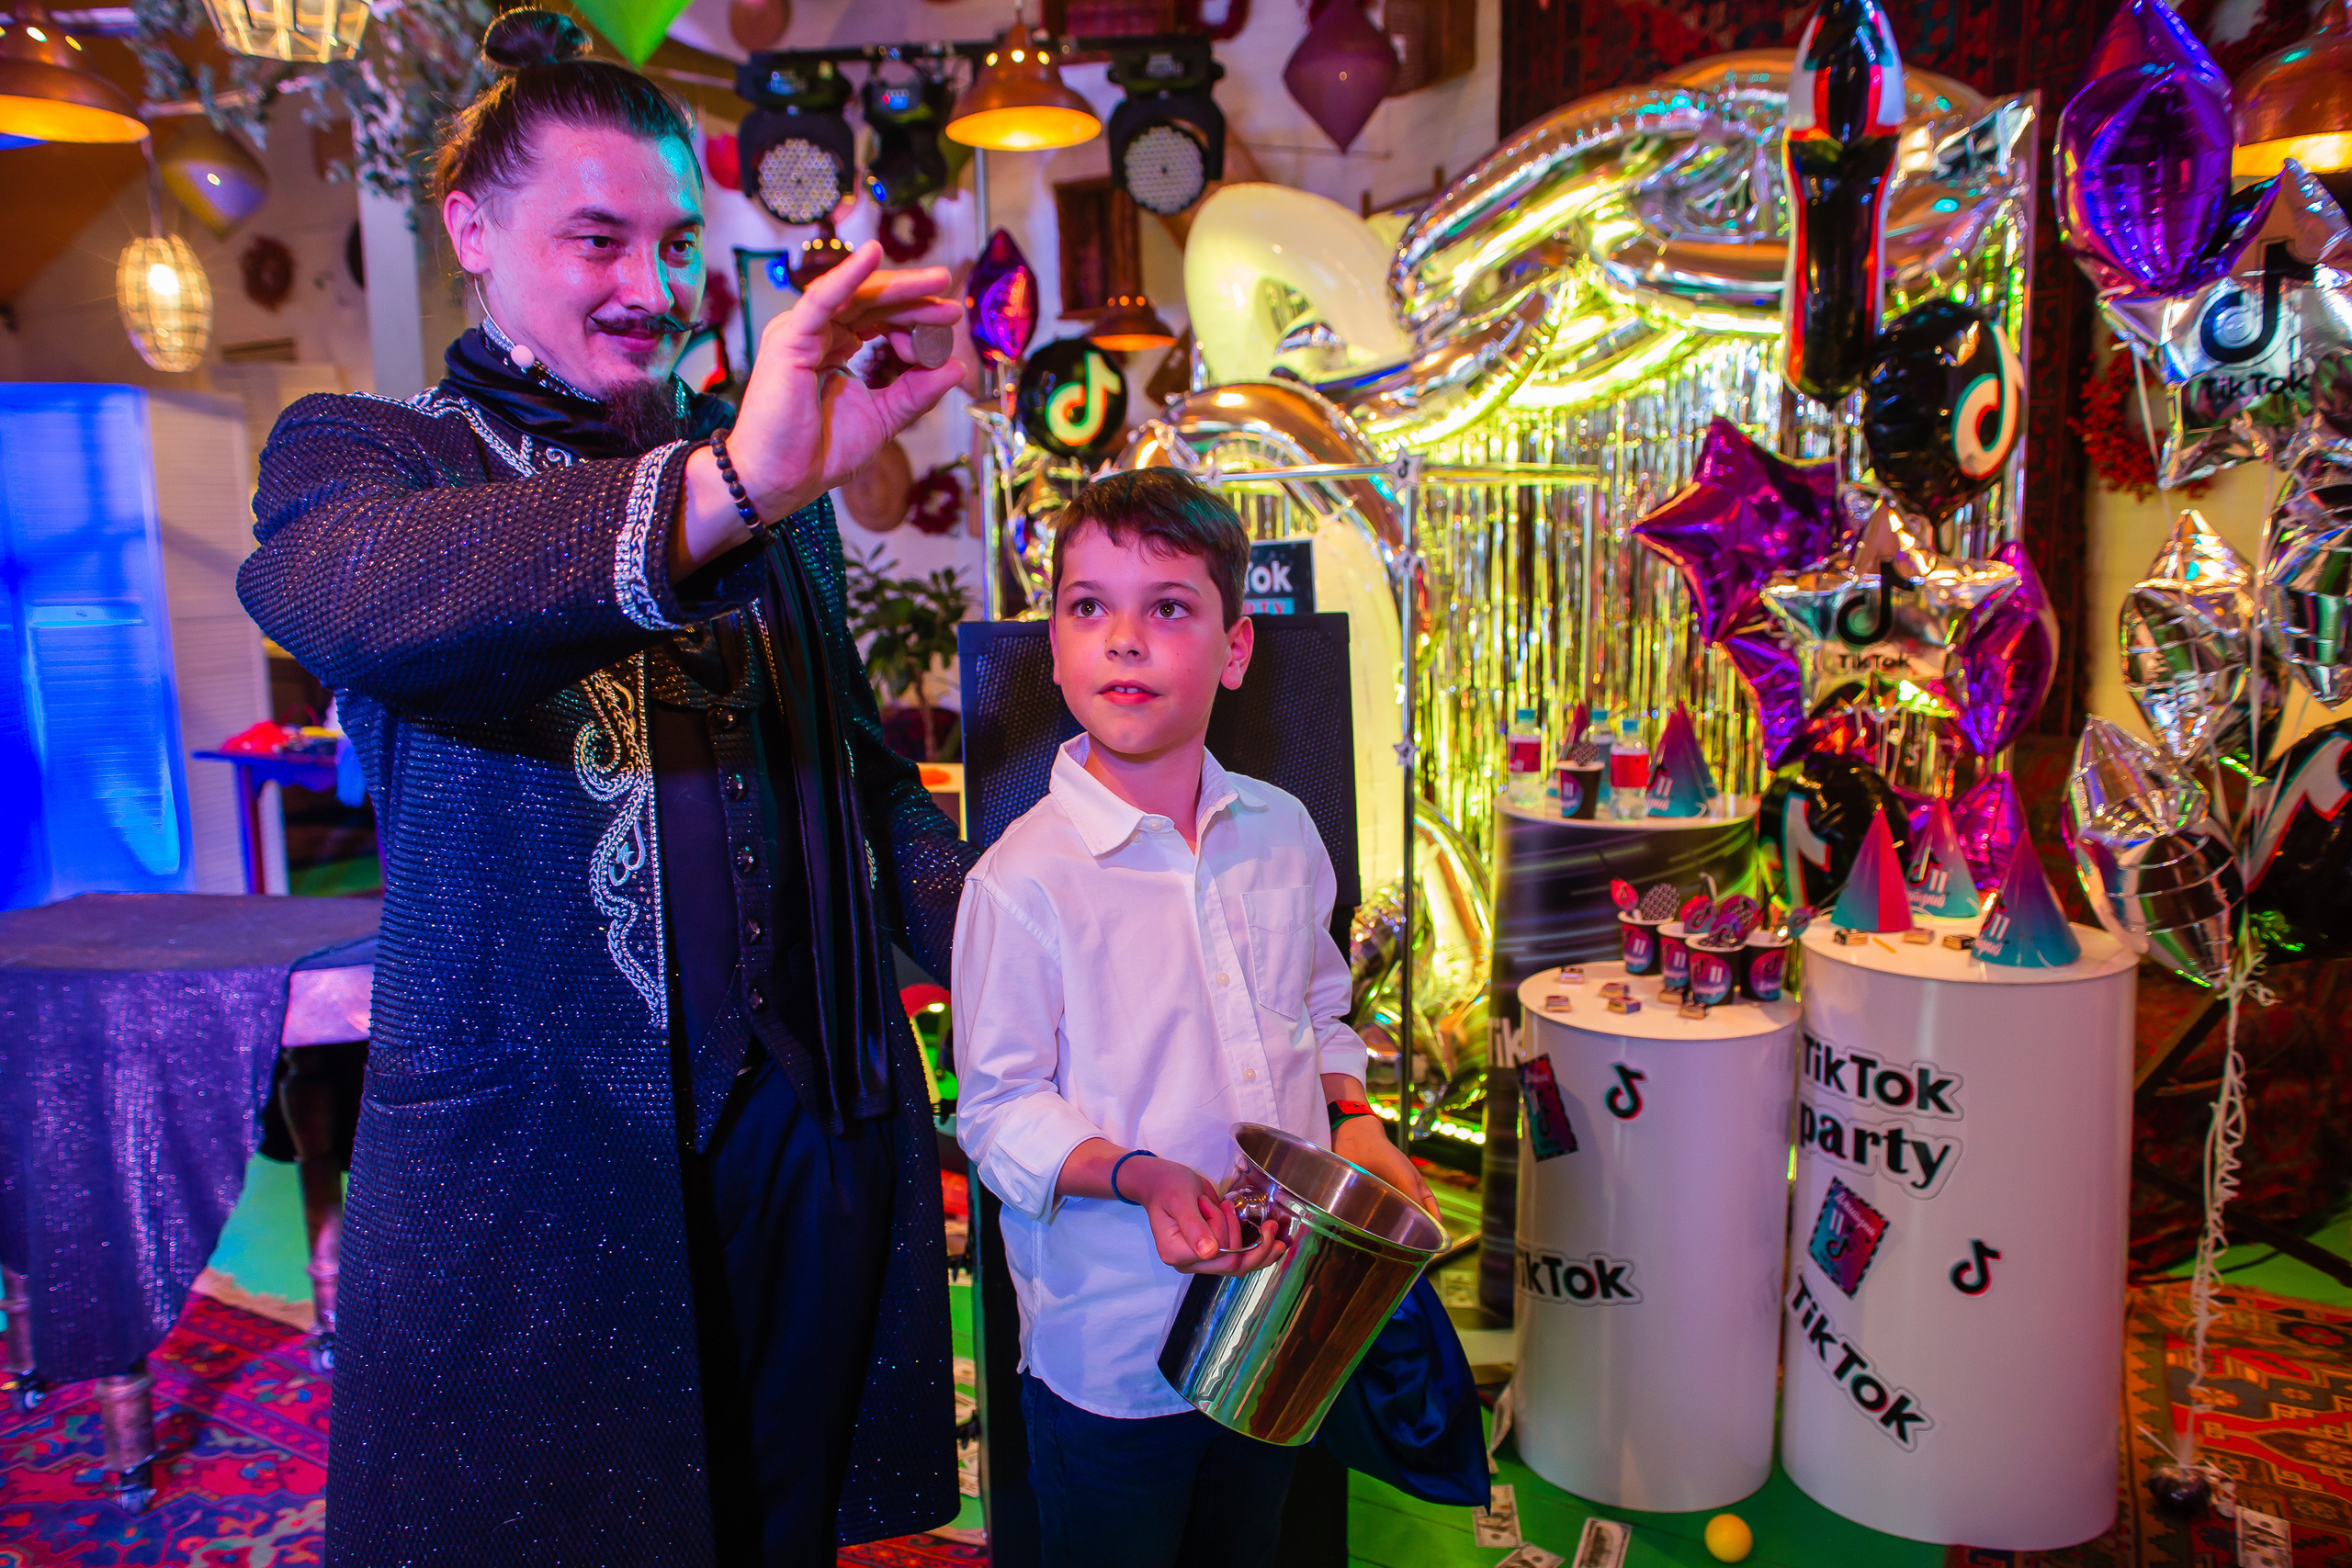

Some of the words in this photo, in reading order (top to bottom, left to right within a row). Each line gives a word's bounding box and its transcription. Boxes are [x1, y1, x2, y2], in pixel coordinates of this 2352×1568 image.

[2201, 371, 2310, 399] TikTok
[1838, 652, 1910, 668] TikTok
[1803, 1032, 1954, 1113] TikTok
[1800, 1102, 1951, 1190] party
[1792, 1273, 1926, 1443] TikTok
